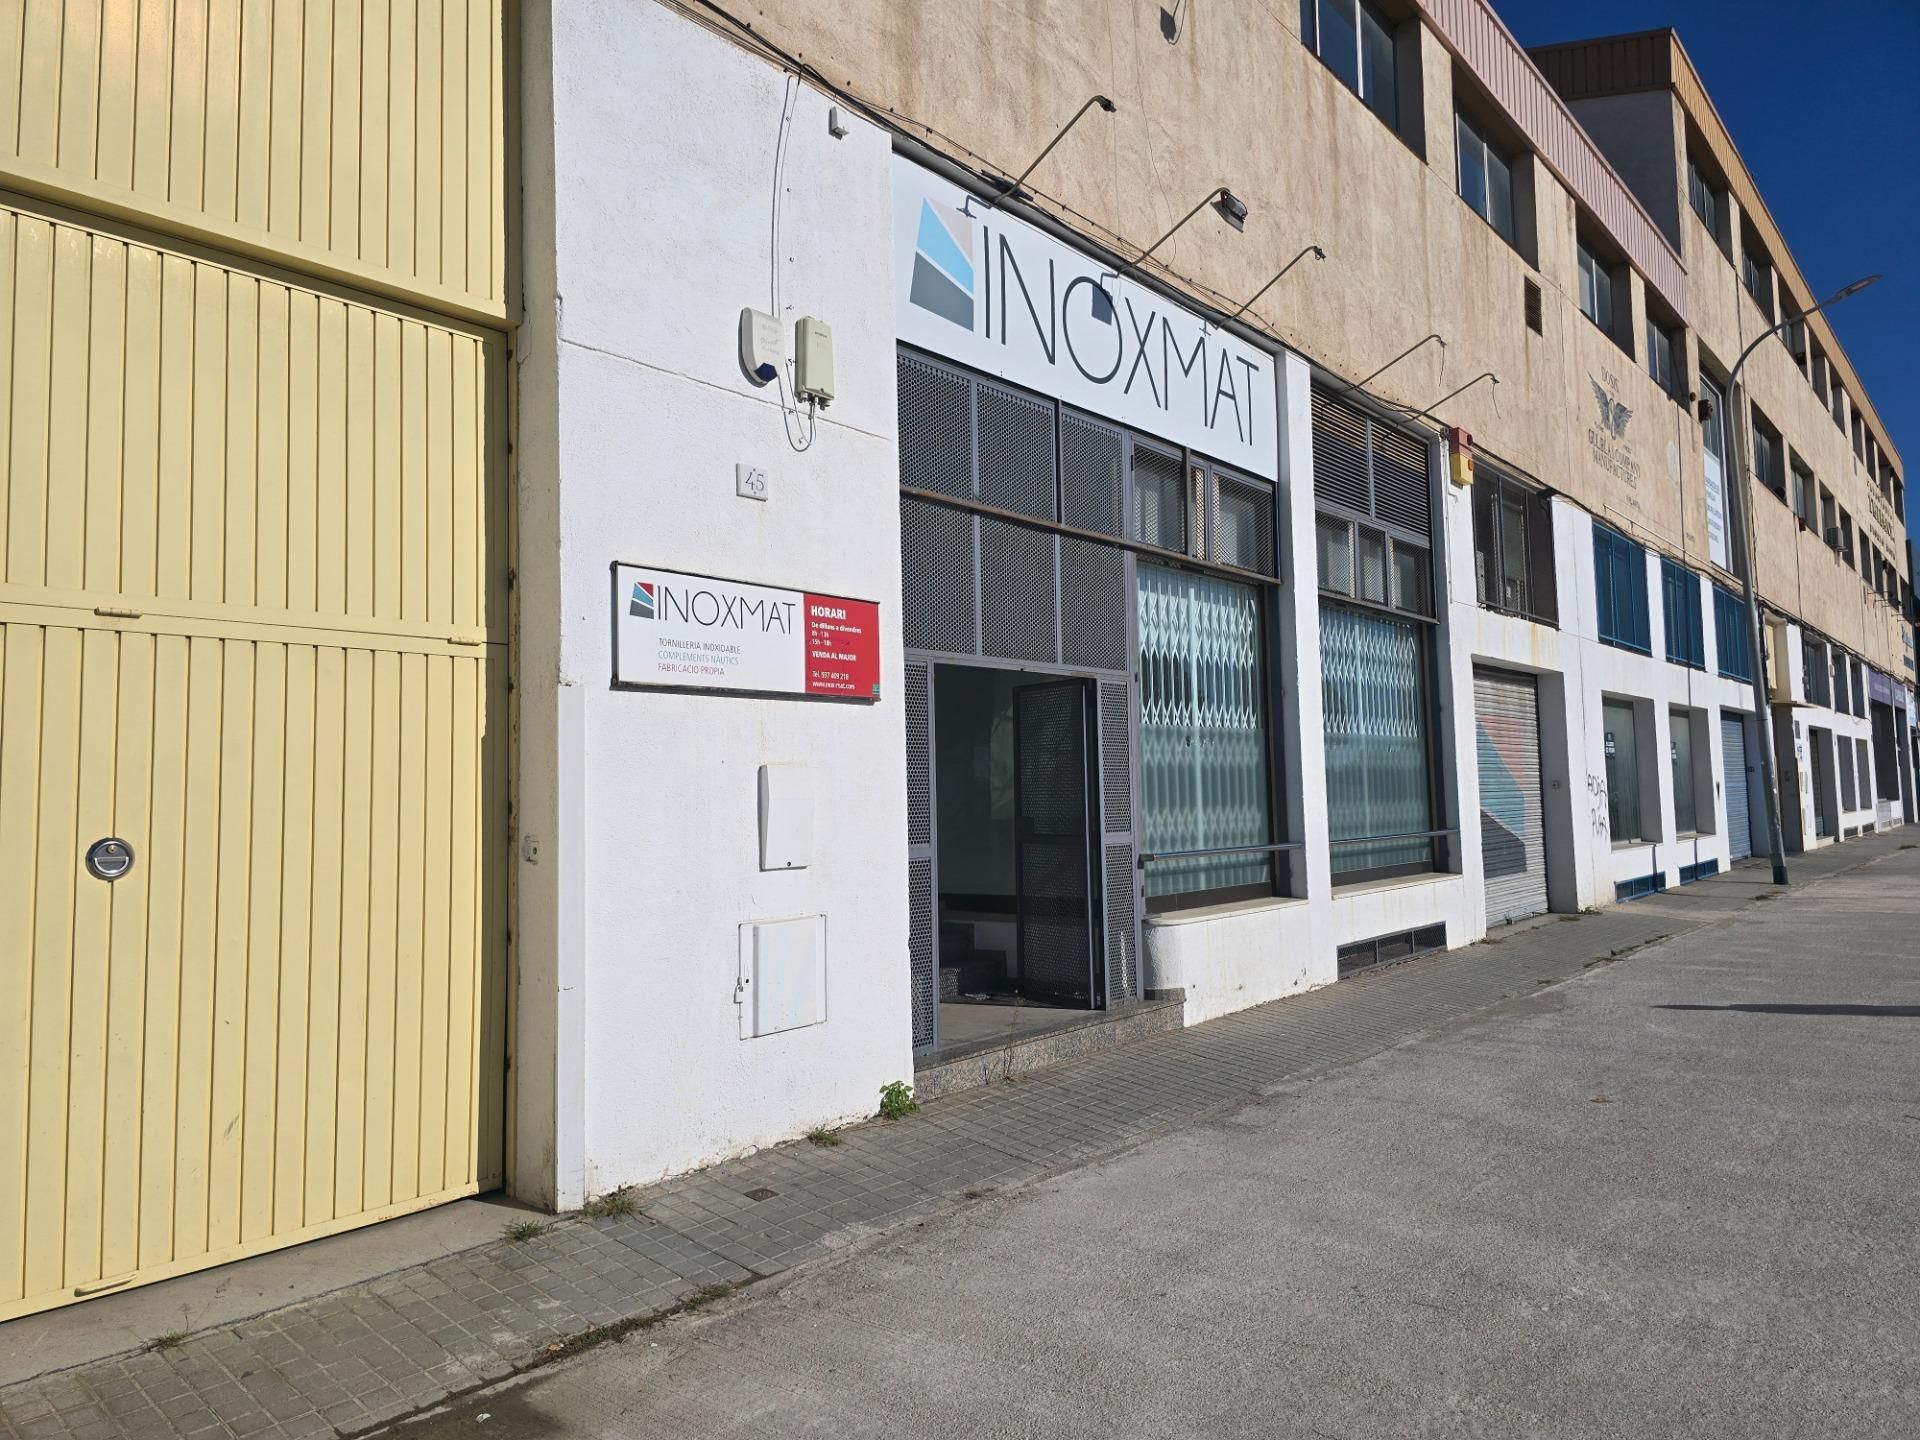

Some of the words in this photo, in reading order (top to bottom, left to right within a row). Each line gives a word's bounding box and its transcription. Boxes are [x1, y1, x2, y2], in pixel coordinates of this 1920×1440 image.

[983, 225, 1259, 446] INOXMAT
[745, 471, 764, 492] 45
[657, 585, 796, 635] INOXMAT
[811, 605, 846, 620] HORARI
[840, 624, 862, 634] divendres
[658, 637, 701, 650] TORNILLERIA
[703, 642, 741, 654] INOXIDABLE
[658, 650, 709, 663] COMPLEMENTS
[812, 650, 830, 659] VENDA
[830, 652, 838, 660] AL
[839, 653, 856, 661] MAJOR
